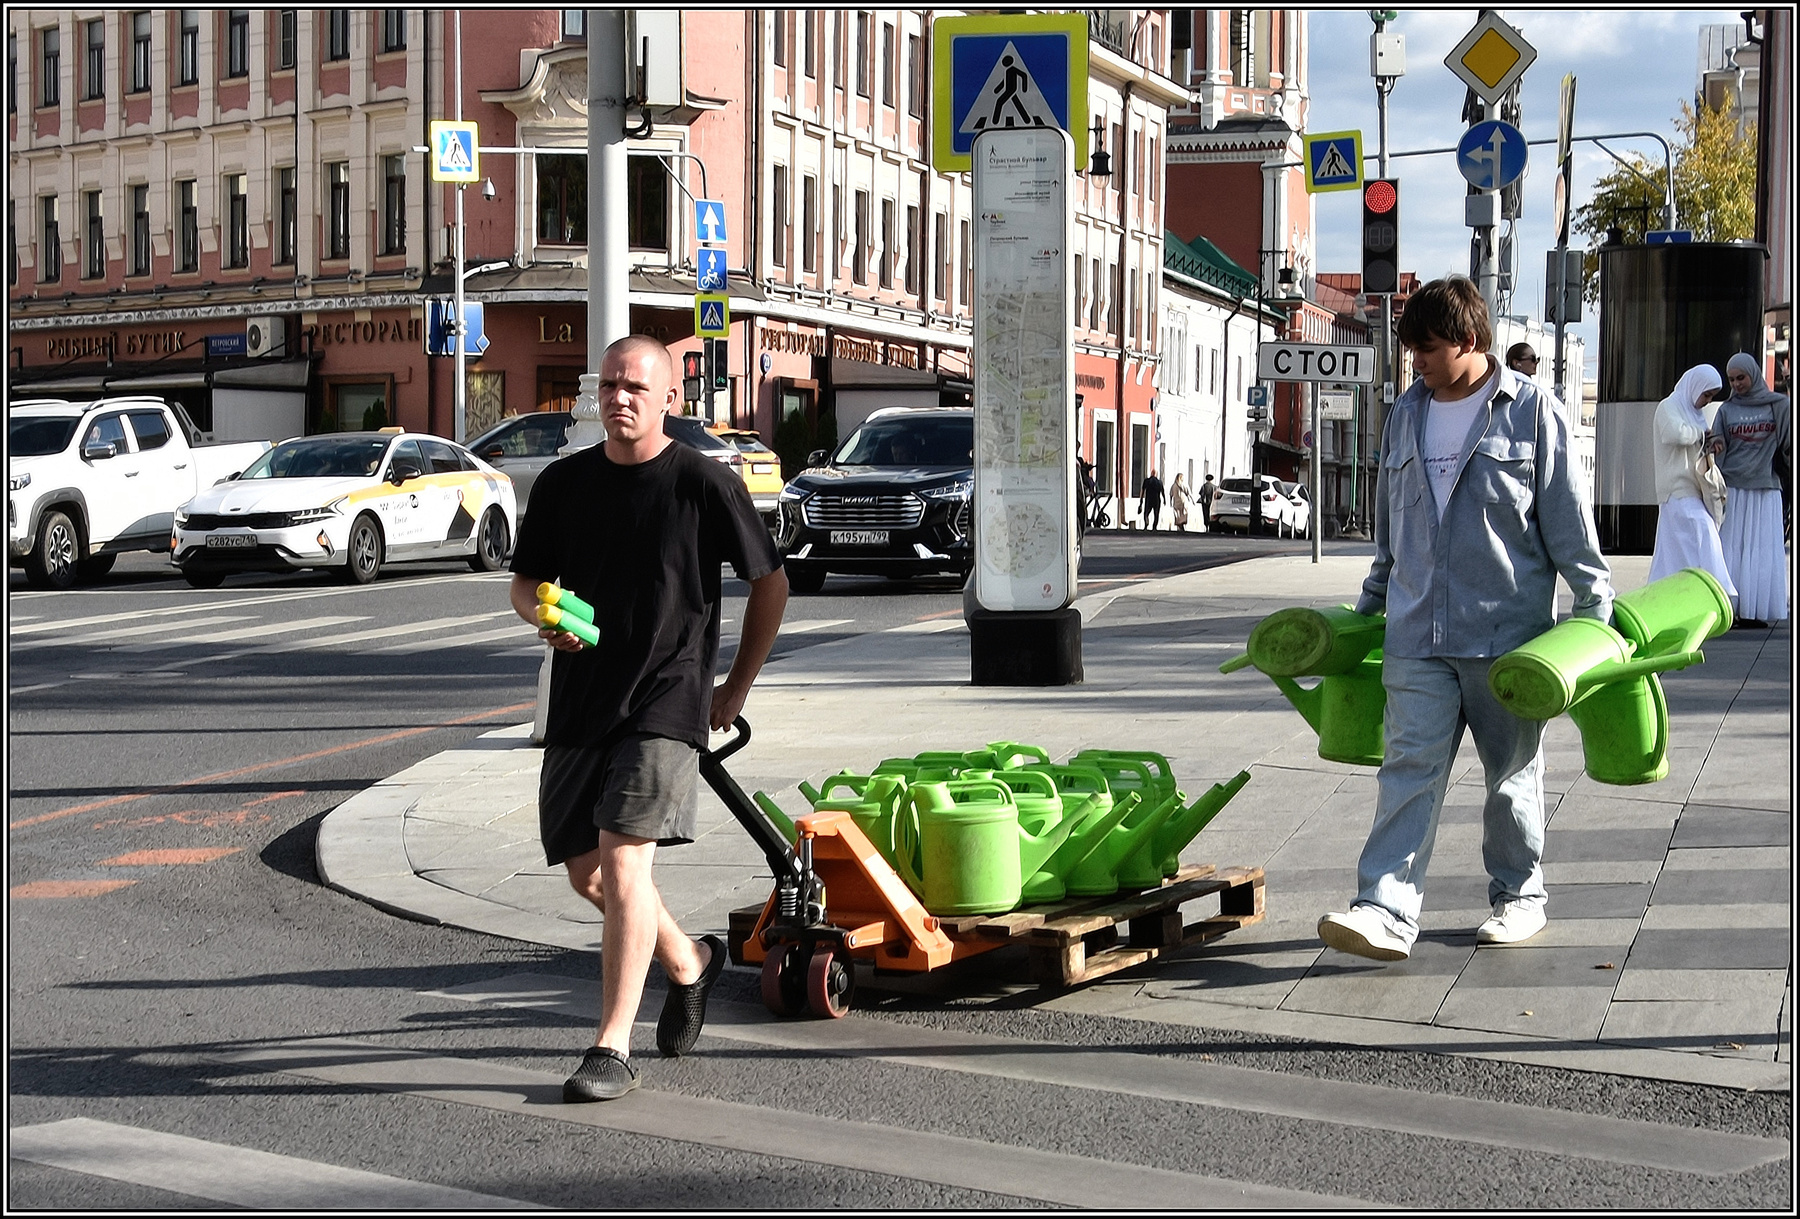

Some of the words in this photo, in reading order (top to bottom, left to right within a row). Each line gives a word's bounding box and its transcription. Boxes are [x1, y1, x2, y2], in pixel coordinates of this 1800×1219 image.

[989, 157, 1020, 165] Страстной
[1022, 156, 1048, 164] бульвар
[309, 318, 420, 345] РЕСТОРАН
[537, 315, 574, 343] La
[760, 327, 826, 358] РЕСТОРАН
[46, 331, 119, 358] РЫБНЫЙ
[126, 330, 185, 354] БУТИК
[1273, 348, 1360, 377] СТОП
[1251, 389, 1264, 405] P
